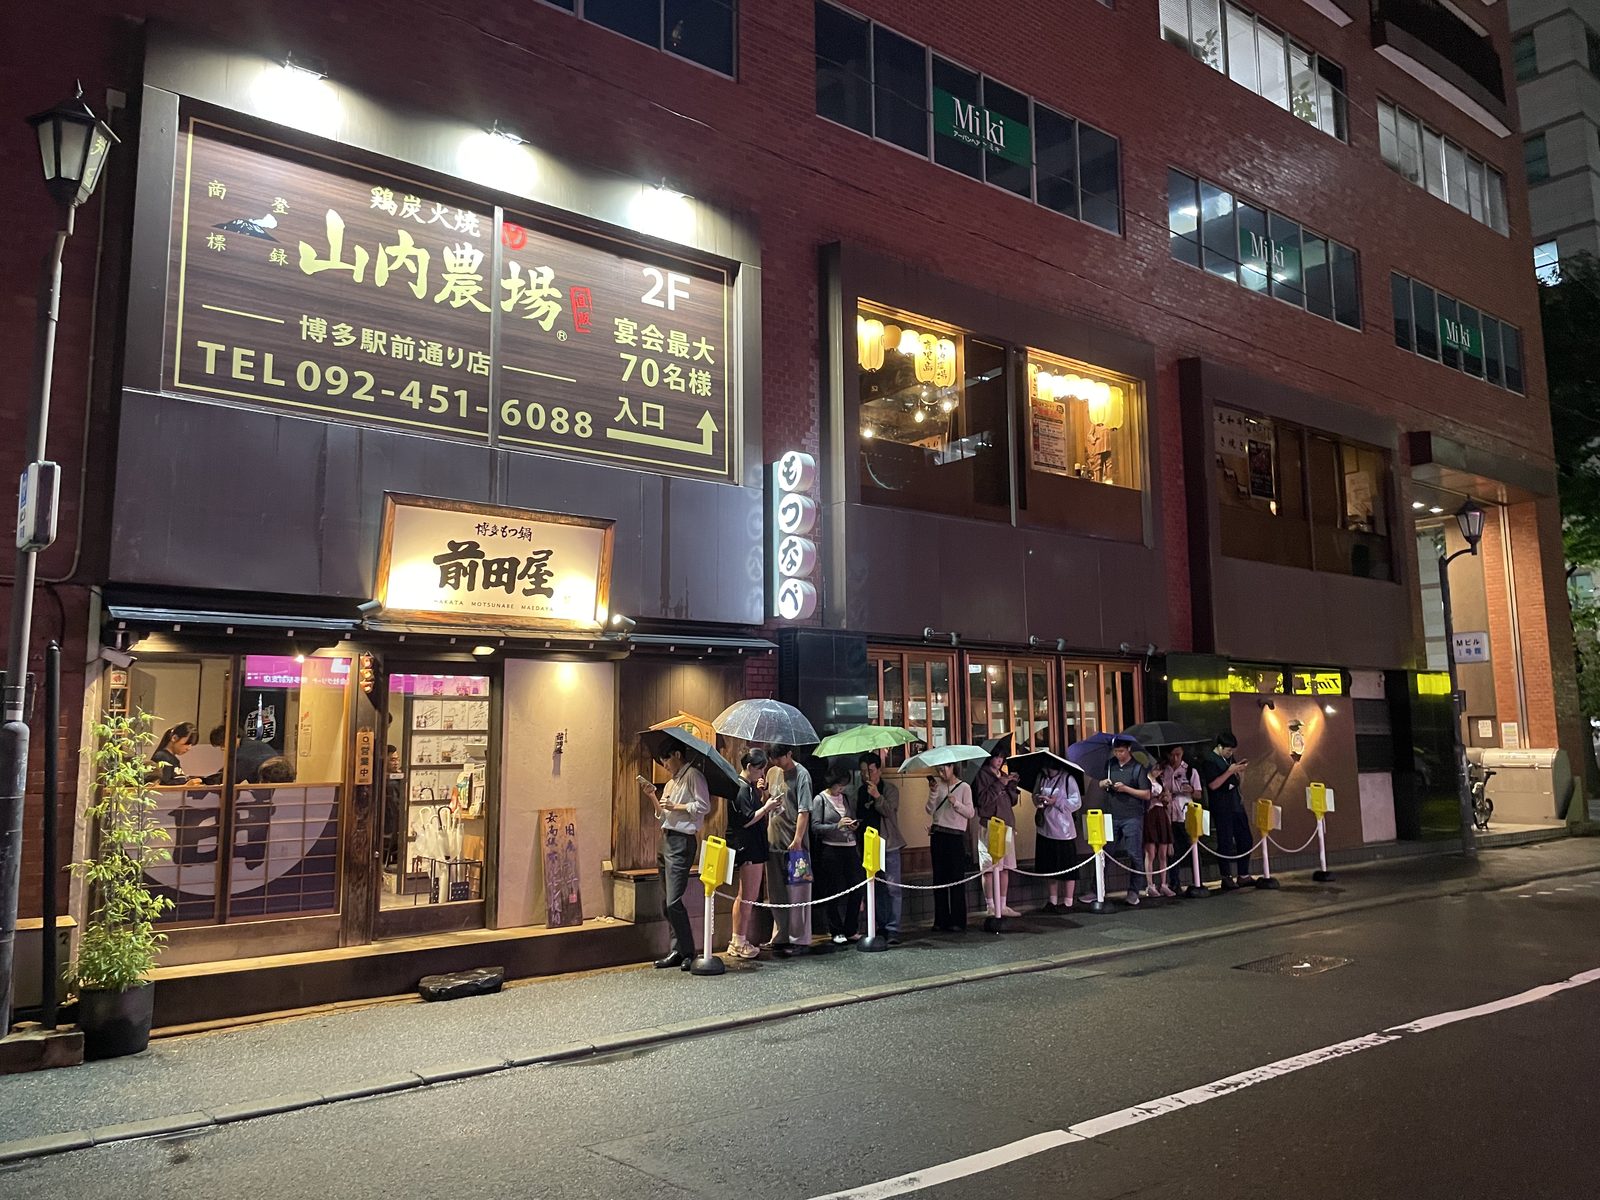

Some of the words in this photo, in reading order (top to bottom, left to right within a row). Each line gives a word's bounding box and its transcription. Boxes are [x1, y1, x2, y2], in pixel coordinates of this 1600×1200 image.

[952, 96, 1005, 147] Miki
[370, 186, 481, 238] 鶏炭火焼
[298, 209, 562, 332] 山内農場
[1250, 231, 1284, 268] Miki
[641, 267, 691, 311] 2F
[299, 314, 491, 377] 博多駅前通り店
[614, 317, 715, 365] 宴会最大
[1444, 317, 1472, 348] Miki
[197, 340, 286, 387] TEL
[296, 360, 593, 438] 092-451-6088
[618, 352, 713, 398] 70名様
[613, 396, 665, 430] 入口
[475, 521, 533, 542] 博多もつ鍋
[781, 455, 800, 611] もつなべ
[433, 540, 554, 599] 前田屋
[471, 601, 515, 609] MOTSUNABE
